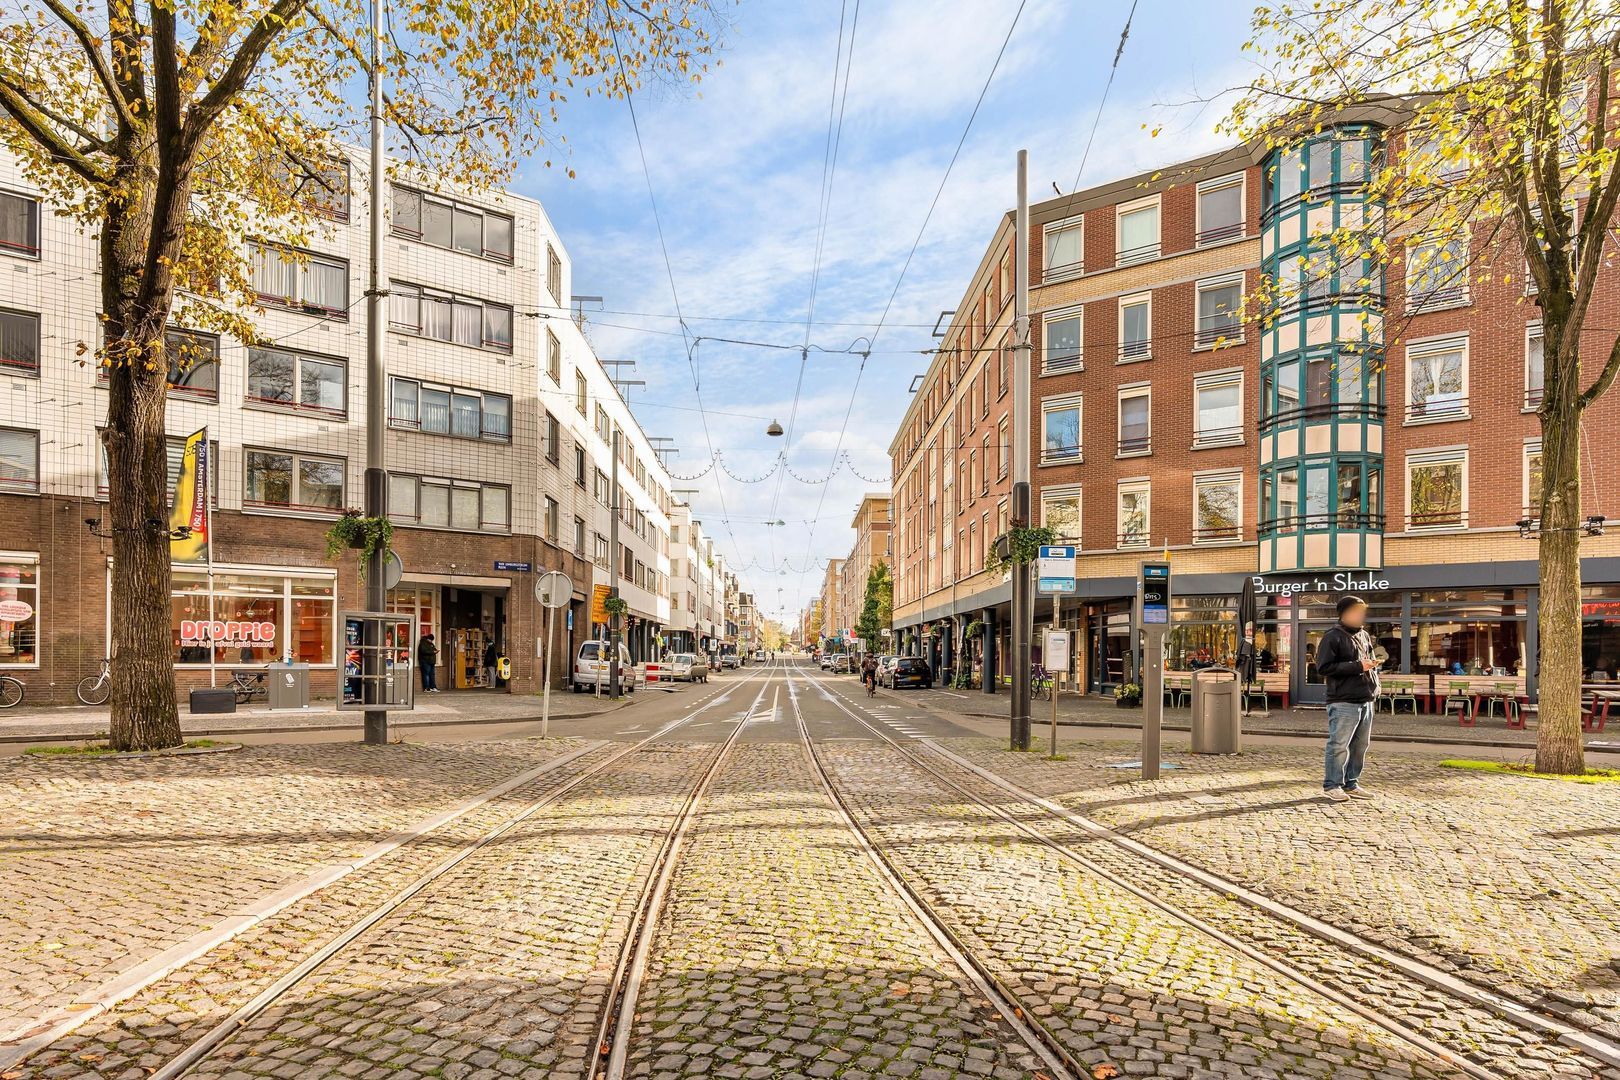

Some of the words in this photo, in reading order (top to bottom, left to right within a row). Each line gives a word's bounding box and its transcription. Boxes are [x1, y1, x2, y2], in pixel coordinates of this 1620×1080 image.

[196, 463, 204, 509] AMSTERDAM
[1252, 576, 1309, 597] Burger
[1333, 572, 1390, 592] Shake
